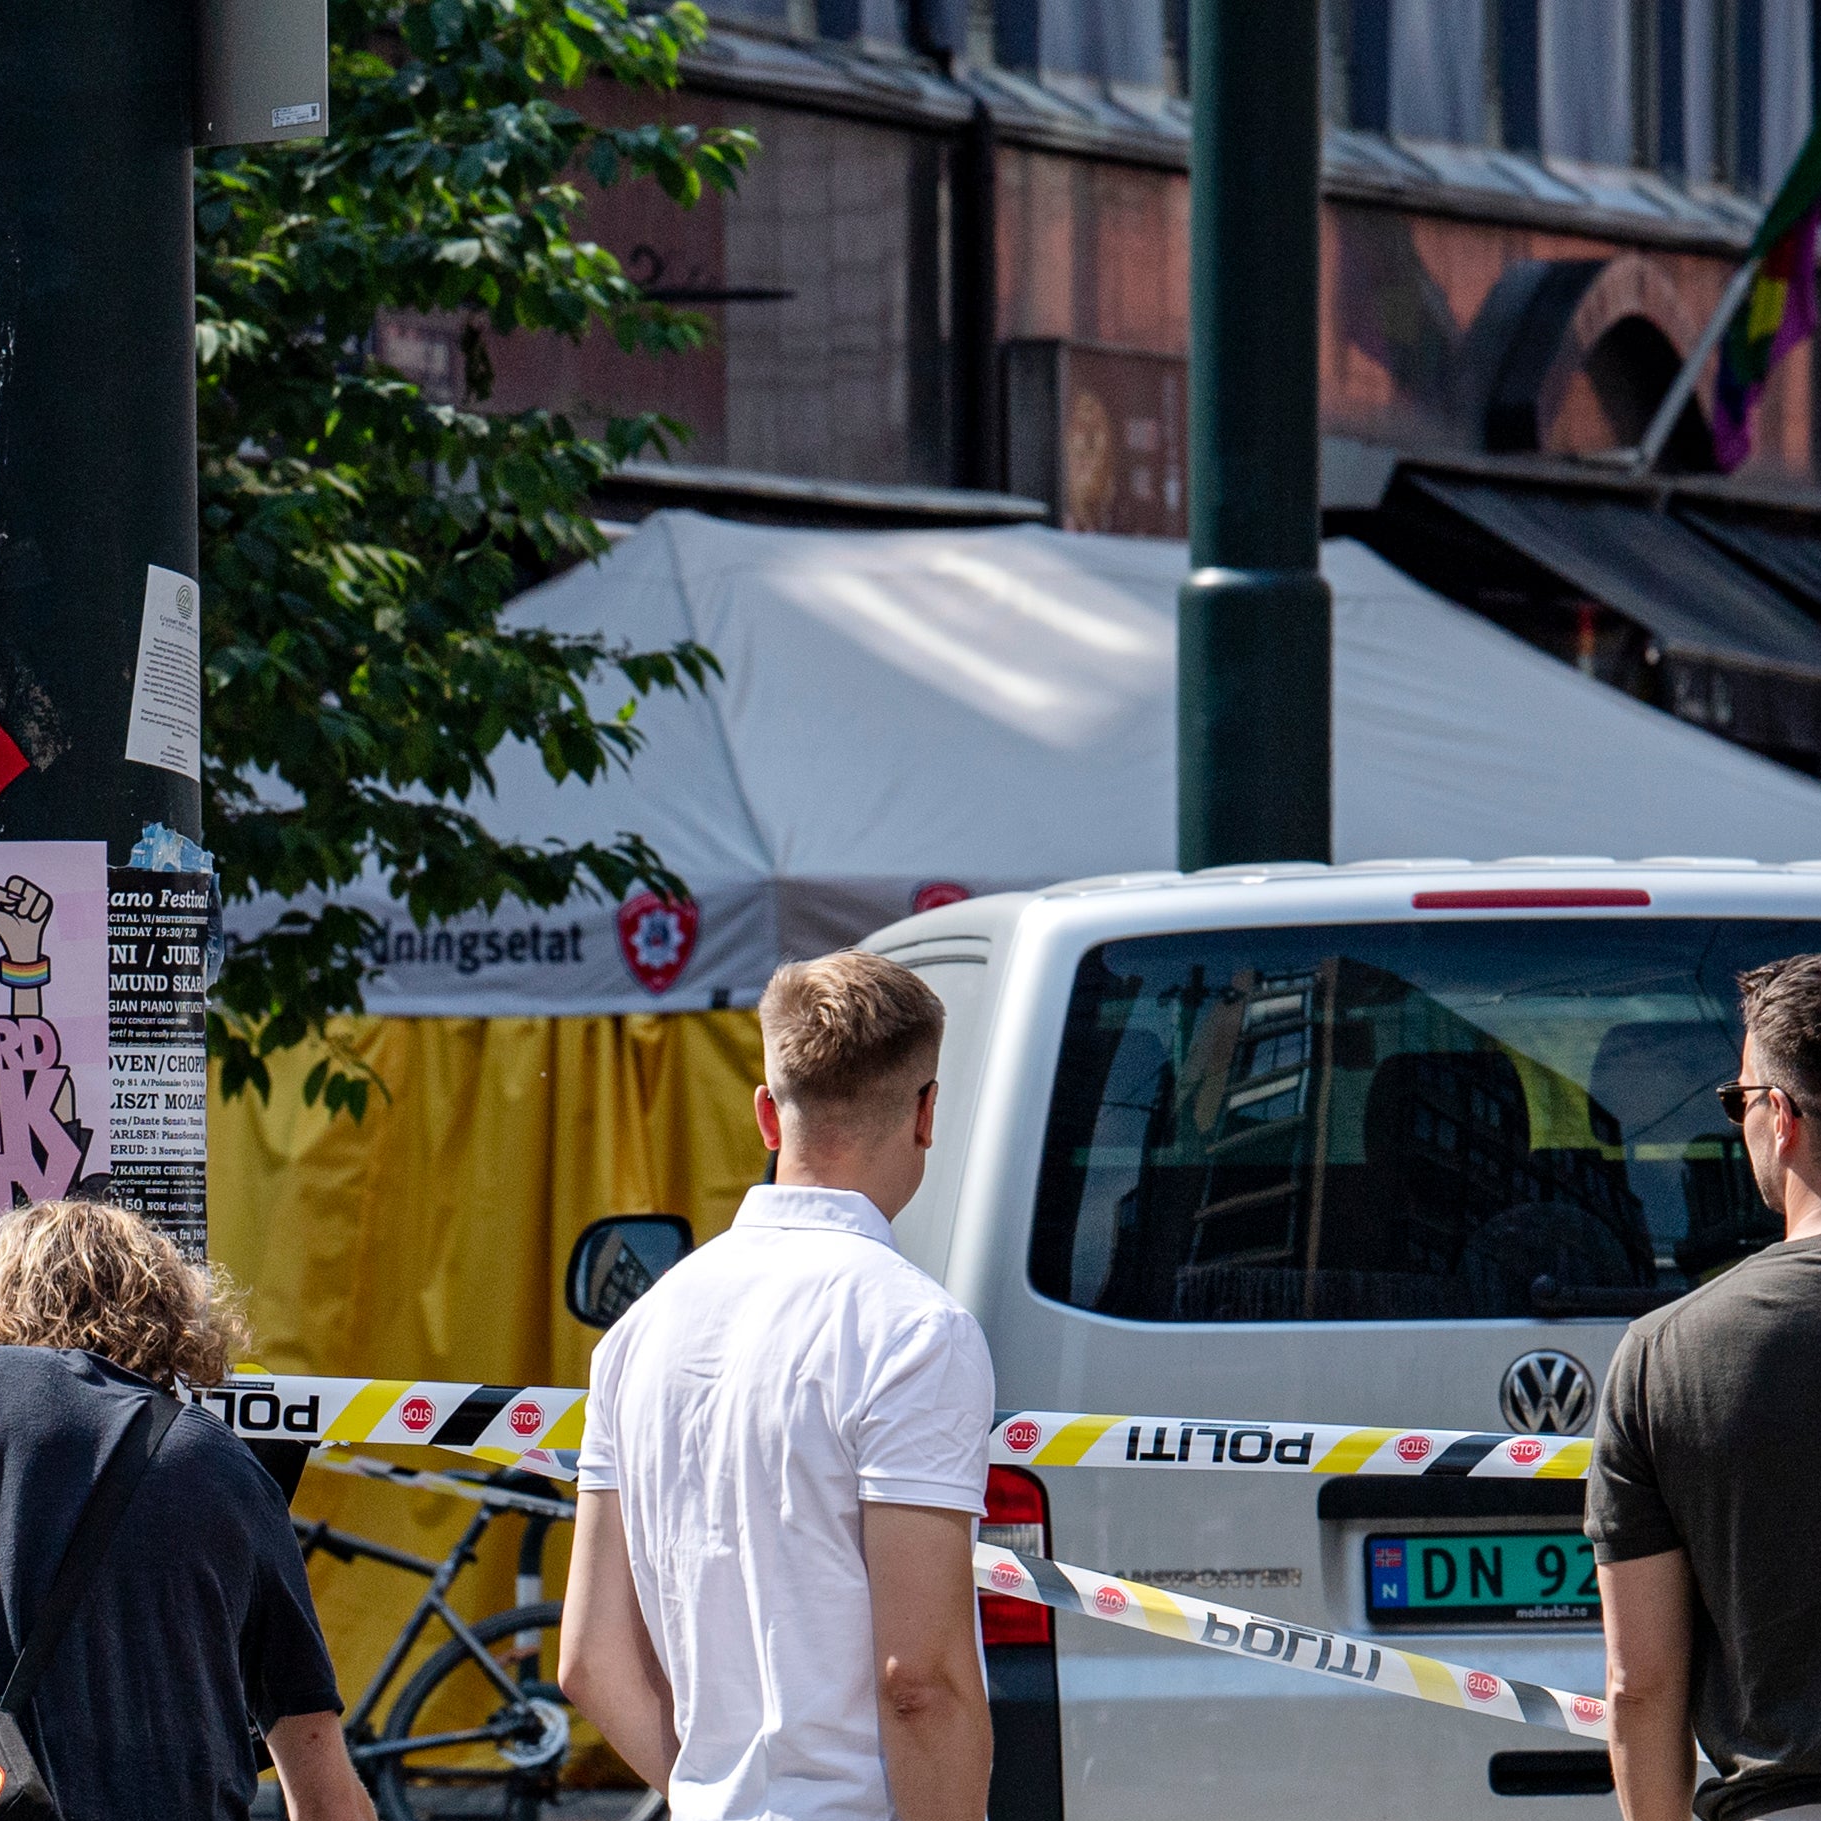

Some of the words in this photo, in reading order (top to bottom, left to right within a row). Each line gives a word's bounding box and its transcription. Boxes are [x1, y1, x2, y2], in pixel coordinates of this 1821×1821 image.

[160, 889, 209, 909] Festival
[108, 914, 139, 923] CITAL
[108, 926, 152, 937] SUNDAY
[369, 920, 584, 975] dningsetat
[163, 946, 200, 965] JUNE
[141, 1001, 173, 1013] PIANO
[109, 1017, 126, 1026] GEL/
[109, 1028, 126, 1038] ert!
[110, 1144, 148, 1155] ERUD:
[151, 1146, 157, 1155] 3
[163, 1166, 194, 1176] CHURCH
[147, 1202, 166, 1211] NOK
[403, 1408, 432, 1422] STOP
[511, 1411, 541, 1425] STOP
[1006, 1427, 1037, 1442] STOP
[1125, 1426, 1315, 1465] POLITI
[1398, 1440, 1429, 1454] STOP
[1510, 1443, 1542, 1456] STOP
[1423, 1546, 1503, 1600] DN
[1382, 1583, 1398, 1599] N
